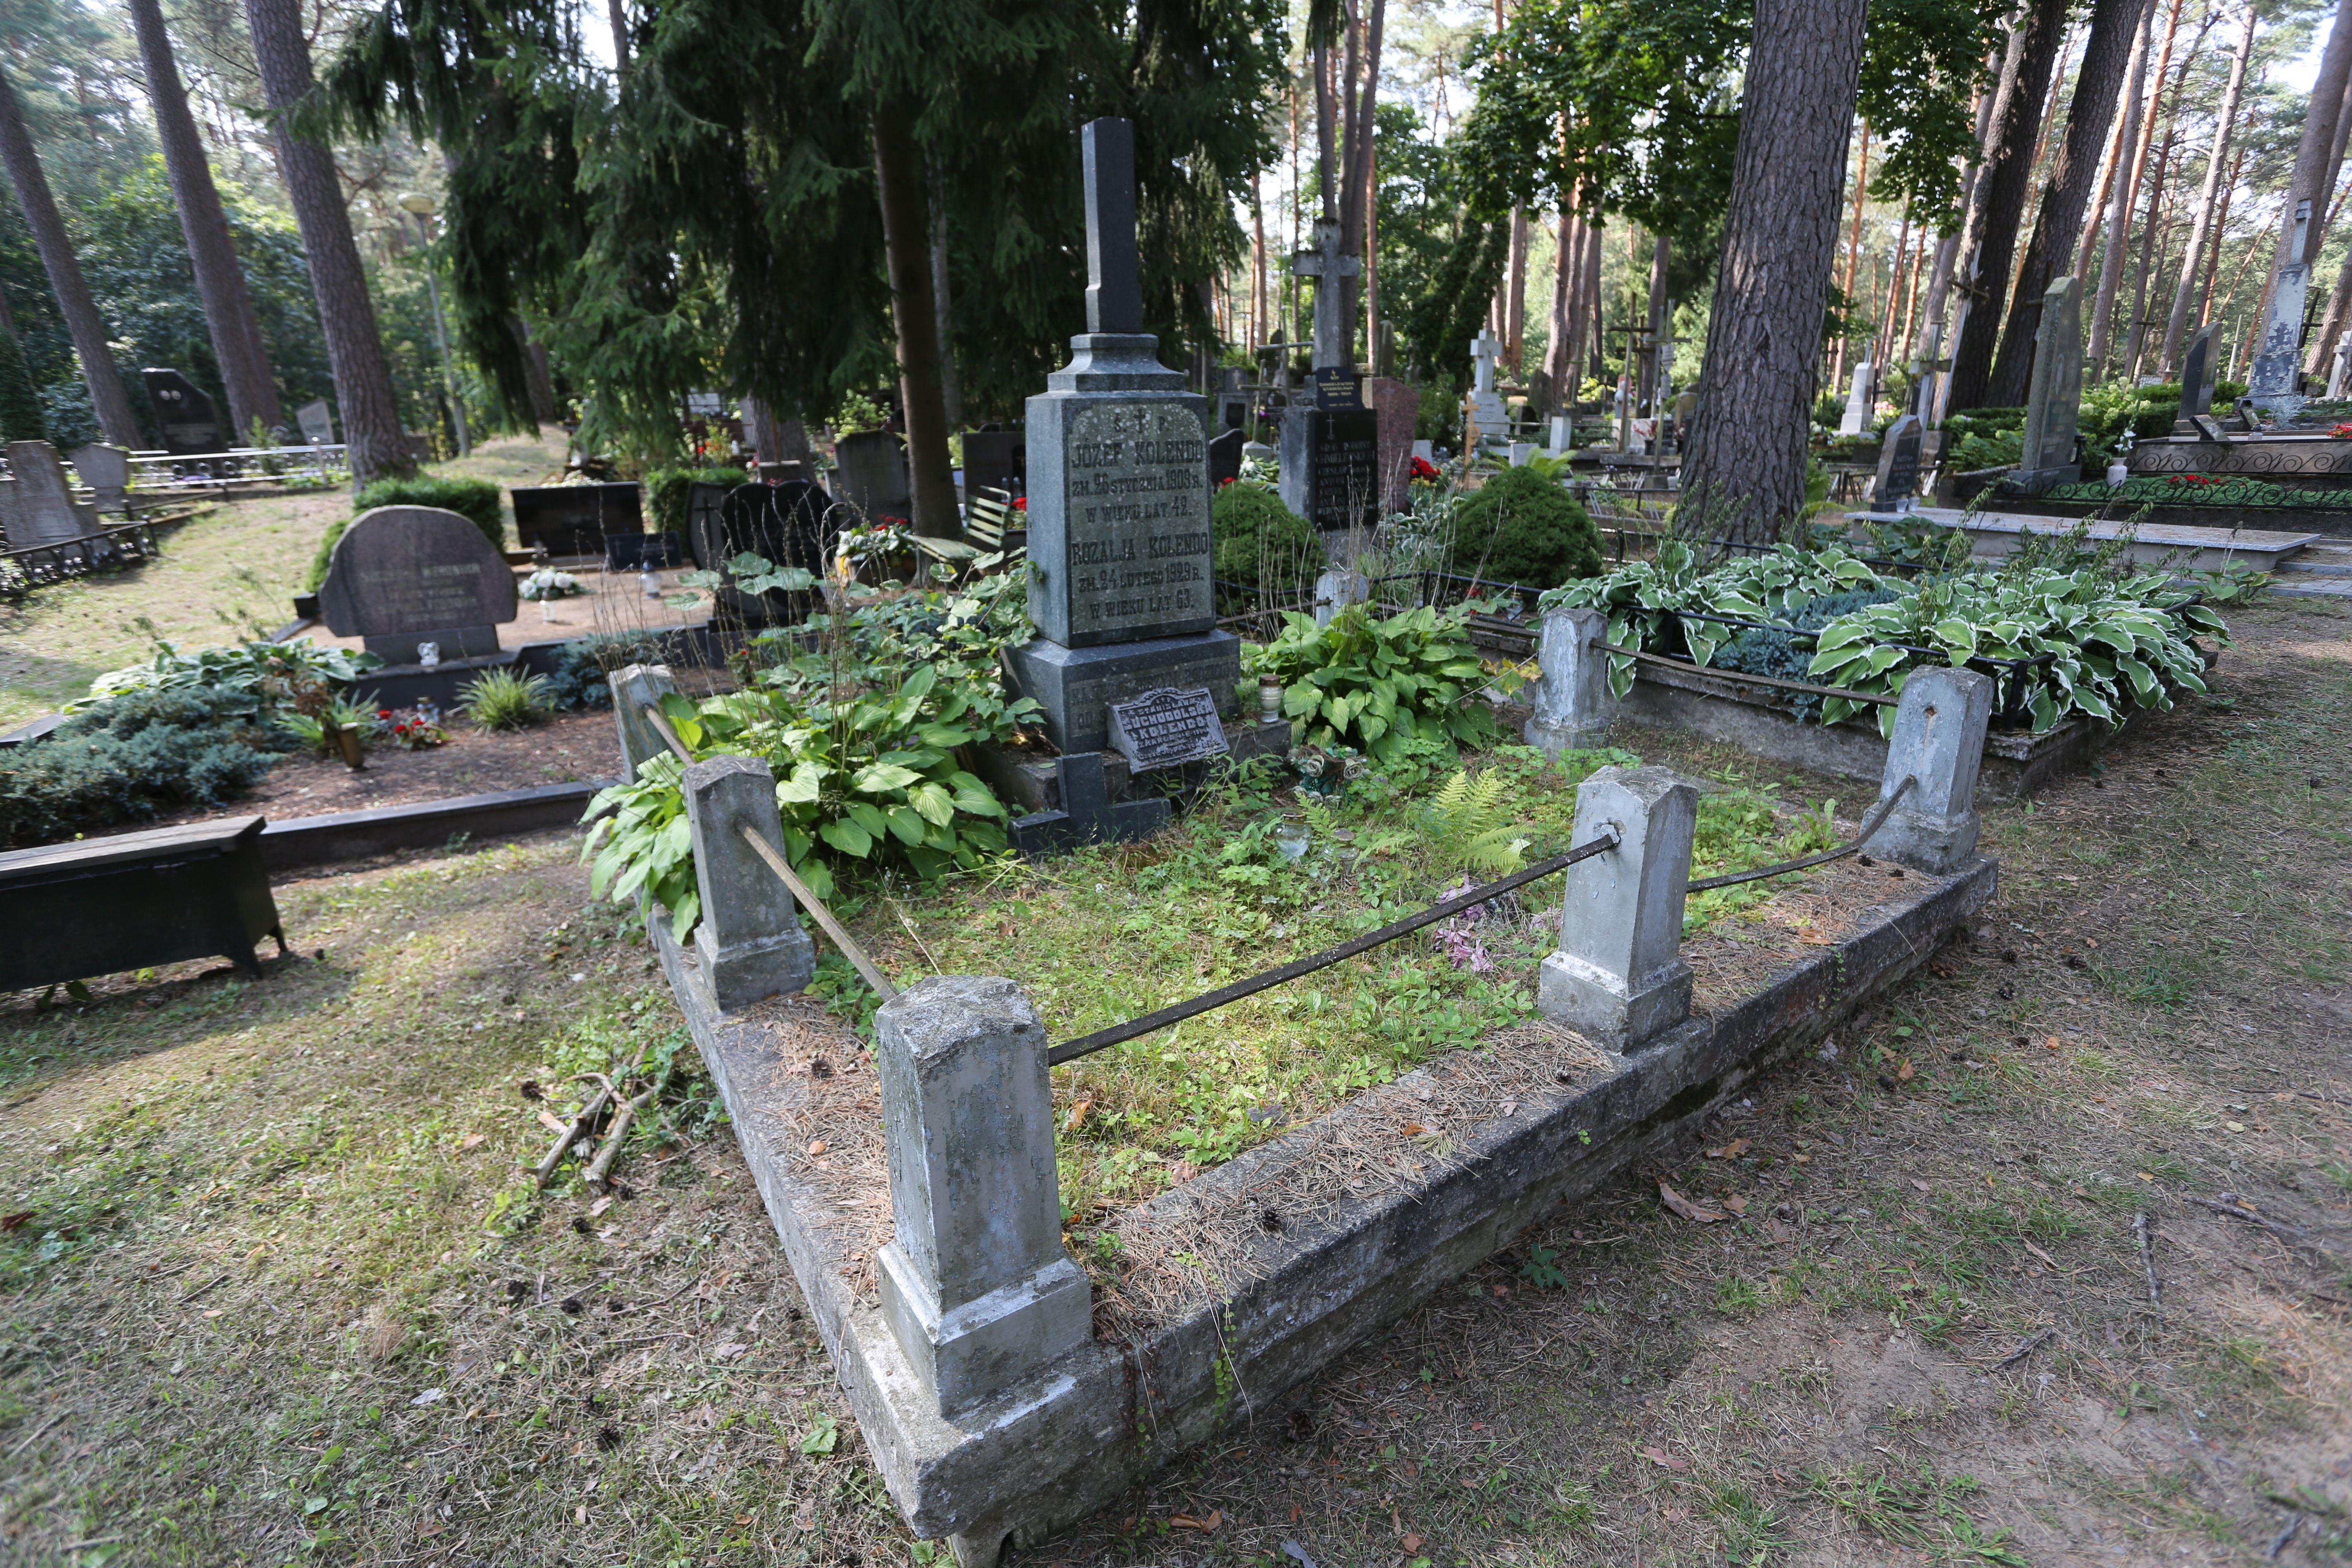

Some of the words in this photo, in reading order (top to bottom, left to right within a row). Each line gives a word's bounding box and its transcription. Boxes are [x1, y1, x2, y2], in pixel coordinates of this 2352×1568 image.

[1071, 437, 1123, 468] JÓZEF
[1134, 439, 1203, 466] KOLENDO
[1071, 479, 1093, 497] ZM.
[1094, 472, 1109, 494] 26
[1111, 475, 1165, 494] STYCZNIA
[1166, 468, 1191, 490] 1909
[1192, 474, 1204, 489] R.
[1085, 506, 1097, 523] W
[1102, 503, 1140, 522] WIEKU
[1144, 502, 1168, 519] LAT
[1172, 495, 1192, 517] 42.
[1071, 537, 1136, 566] ROZALJA
[1148, 532, 1209, 559] KOLENDO
[1078, 576, 1099, 593] ZM.
[1100, 569, 1117, 591] 24
[1120, 569, 1164, 588] LUTEGO
[1165, 561, 1191, 584] 1929
[1192, 566, 1205, 581] R.
[1089, 603, 1100, 619] W
[1105, 597, 1144, 618] WIEKU
[1149, 595, 1172, 612] LAT
[1176, 587, 1194, 610] 63.
